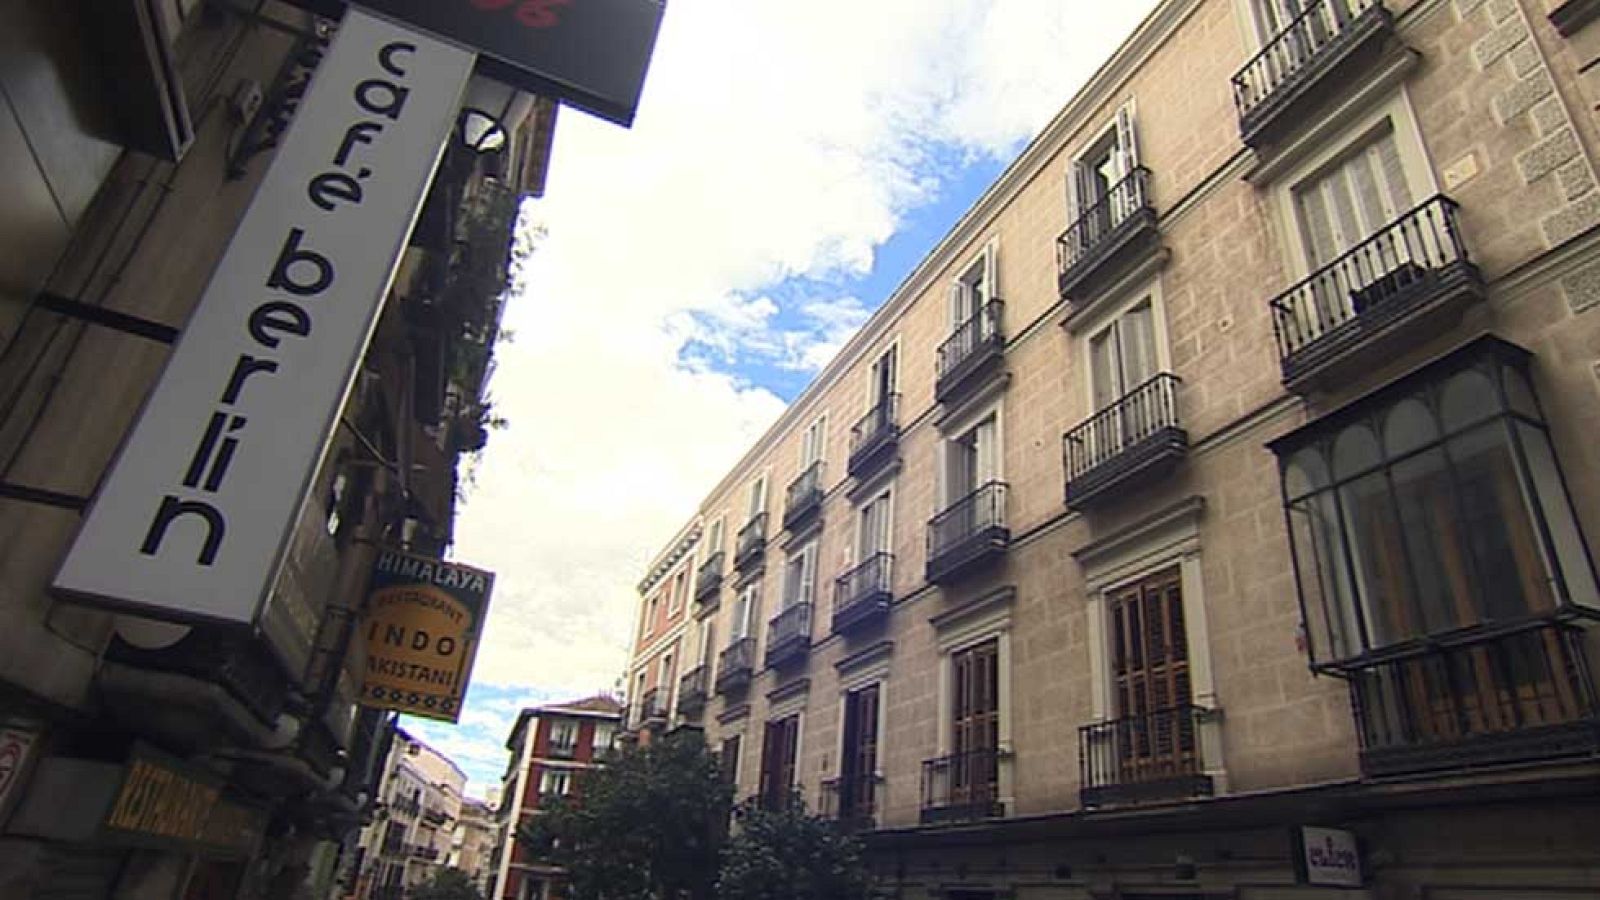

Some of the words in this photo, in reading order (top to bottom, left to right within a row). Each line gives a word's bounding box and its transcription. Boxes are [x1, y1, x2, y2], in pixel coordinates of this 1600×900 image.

[307, 41, 418, 212] café
[139, 228, 334, 567] berlin
[377, 551, 486, 594] HIMALAYA
[368, 621, 456, 657] INDO
[367, 655, 455, 687] AKISTANI
